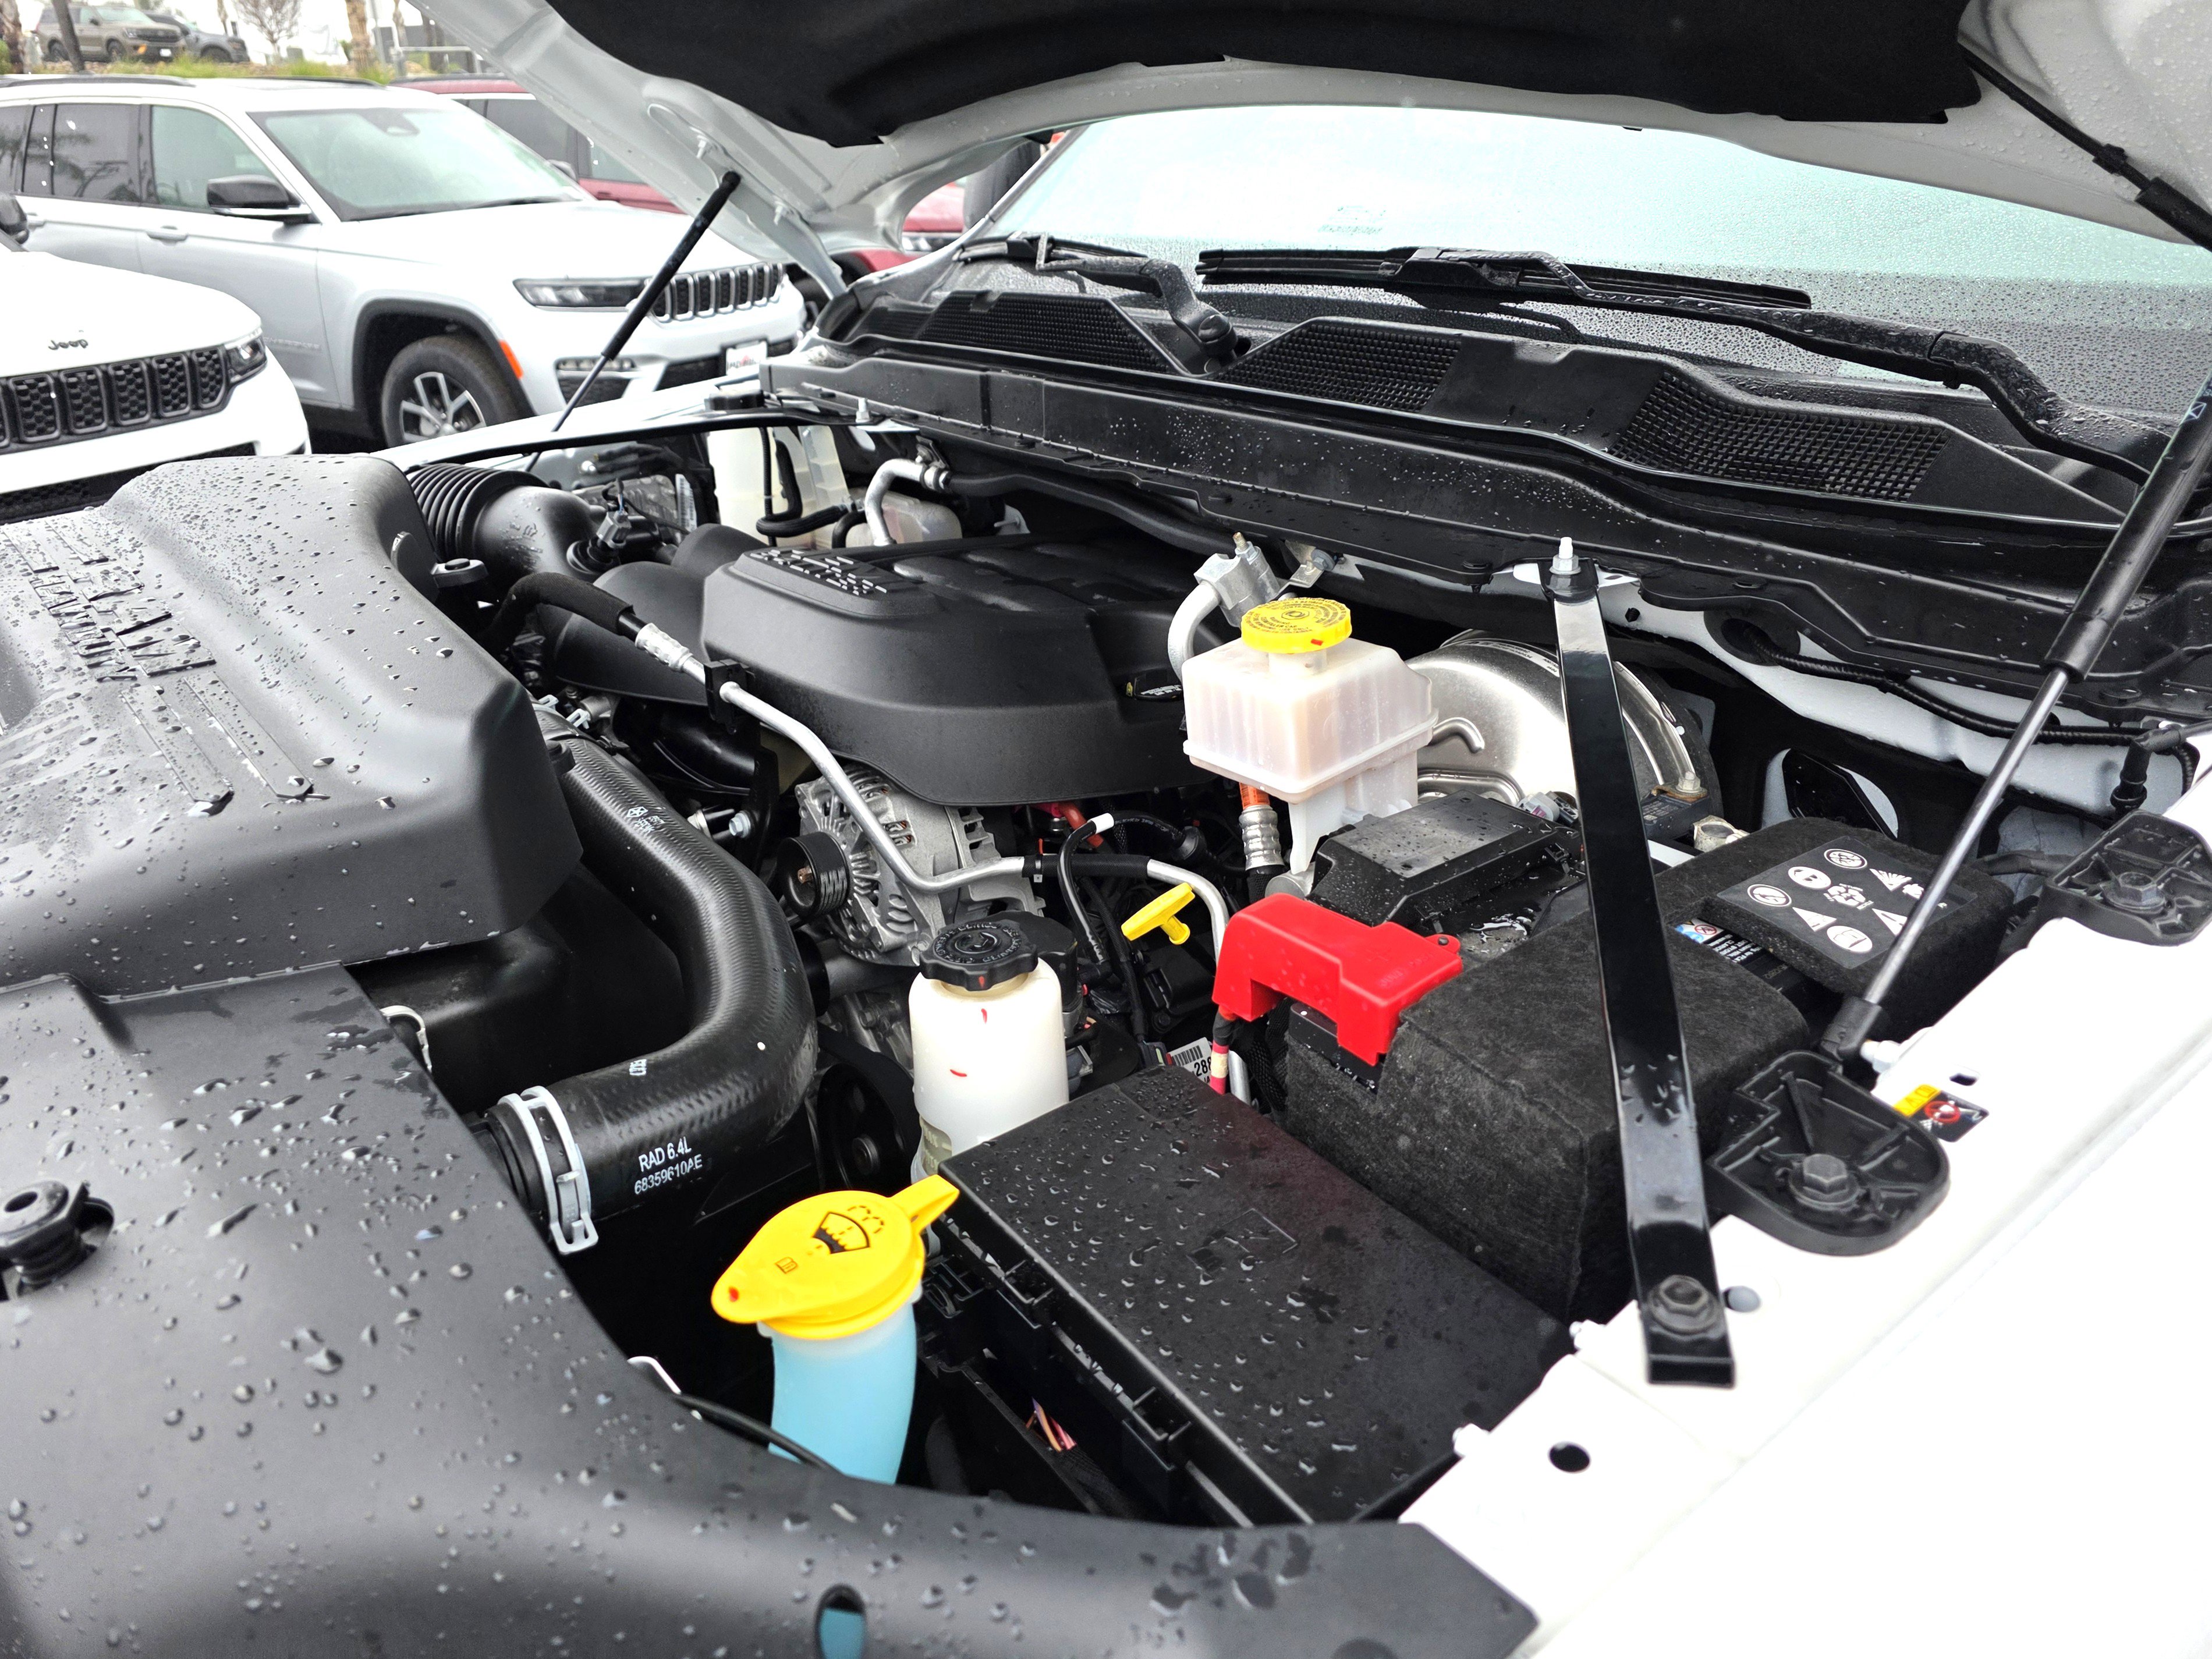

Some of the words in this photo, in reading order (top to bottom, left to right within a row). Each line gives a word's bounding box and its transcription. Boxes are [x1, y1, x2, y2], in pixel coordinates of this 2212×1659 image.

[48, 339, 88, 350] Jeep
[638, 1147, 665, 1172] RAD
[667, 1136, 692, 1160] 6.4L
[634, 1153, 703, 1194] 68359610AE
